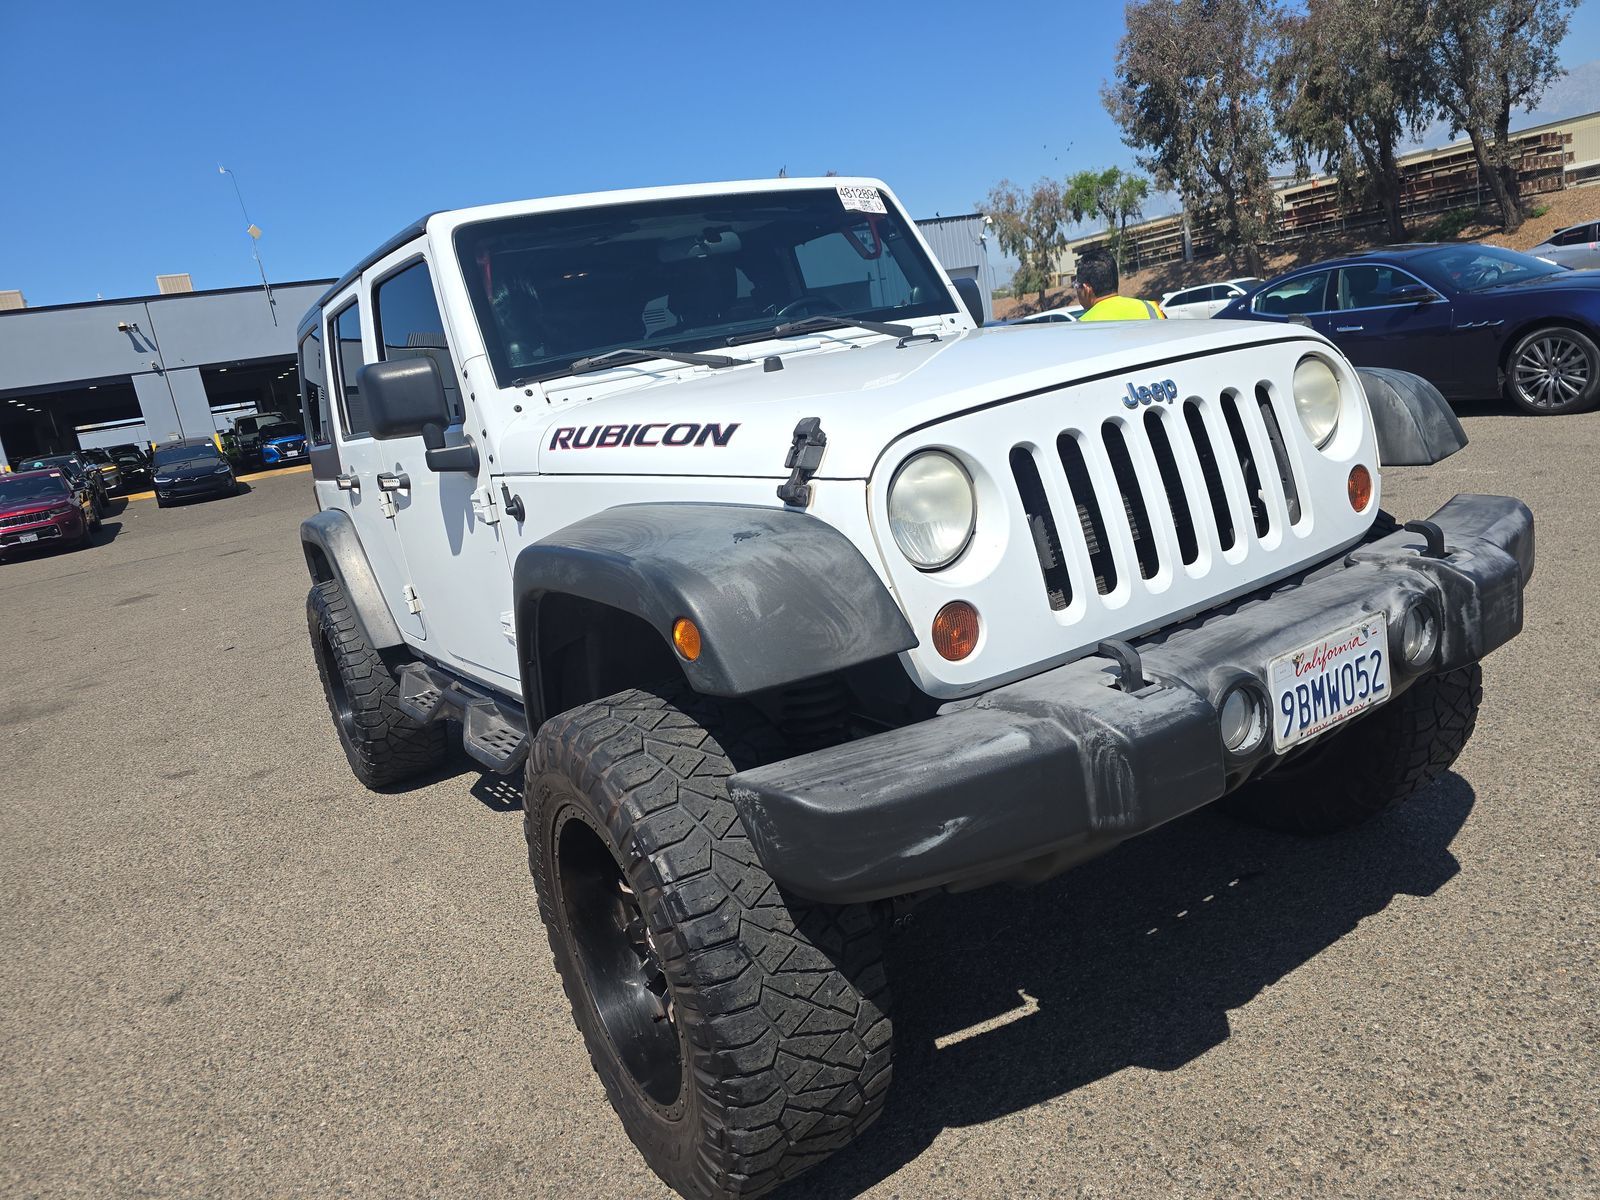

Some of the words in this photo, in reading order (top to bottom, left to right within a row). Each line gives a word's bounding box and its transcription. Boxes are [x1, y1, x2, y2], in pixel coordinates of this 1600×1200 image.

[840, 187, 881, 200] 4812894
[1122, 379, 1177, 410] Jeep
[549, 423, 743, 451] RUBICON
[1295, 635, 1367, 677] California
[1281, 649, 1385, 738] 9BMW052
